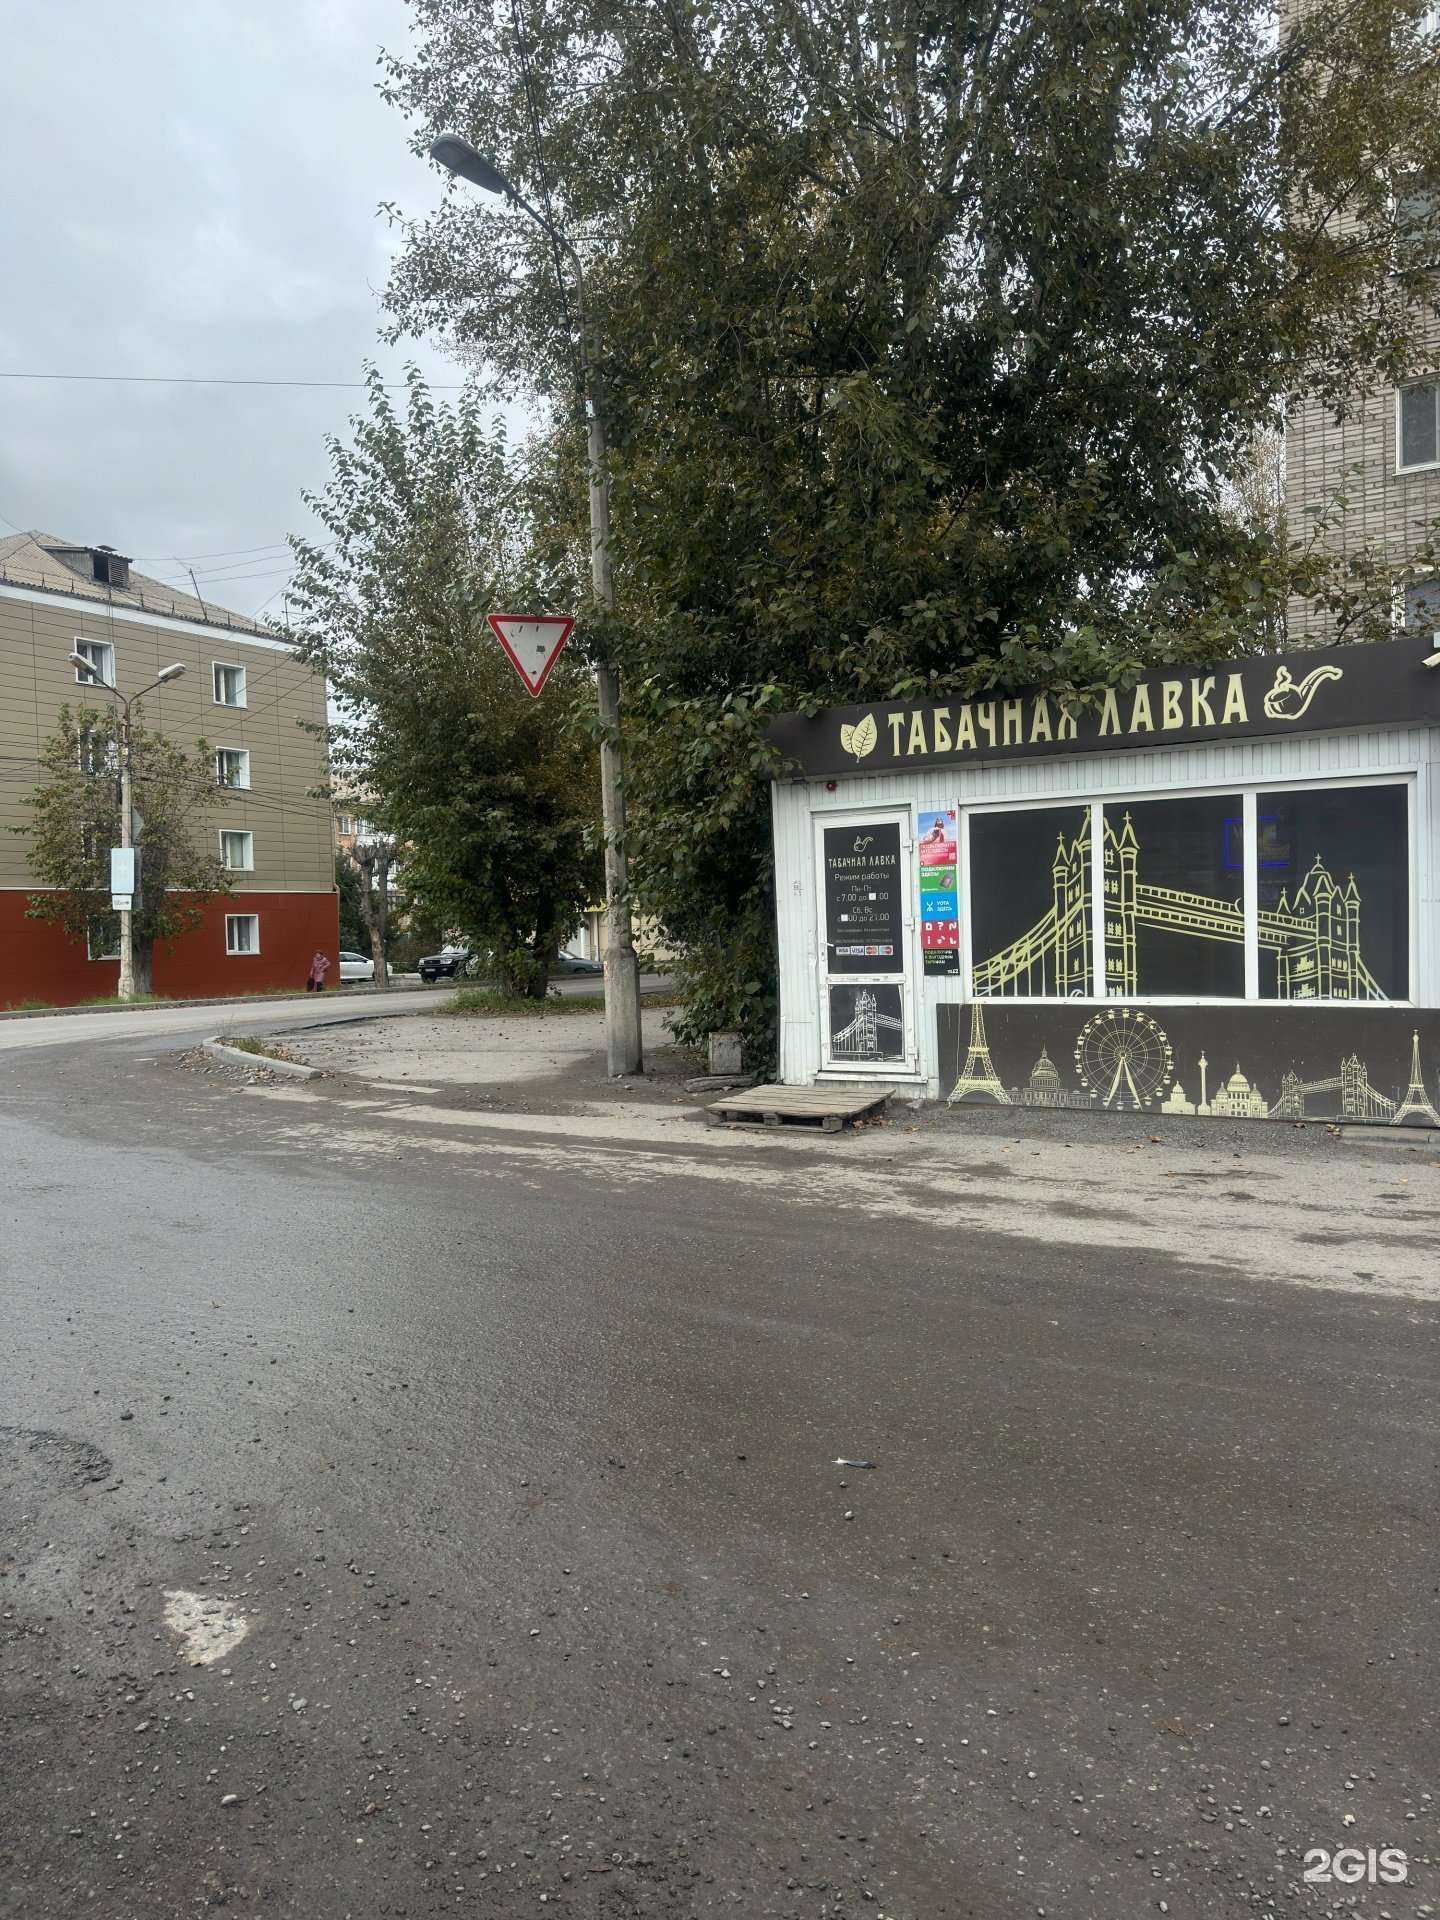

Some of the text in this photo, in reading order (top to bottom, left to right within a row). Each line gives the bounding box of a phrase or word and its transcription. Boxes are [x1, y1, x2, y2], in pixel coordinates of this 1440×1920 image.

[887, 673, 1250, 757] ТАБАЧНАЯ ЛАВКА
[828, 854, 896, 868] ТАБАЧНАЯ ЛАВКА
[834, 871, 890, 881] Режим работы
